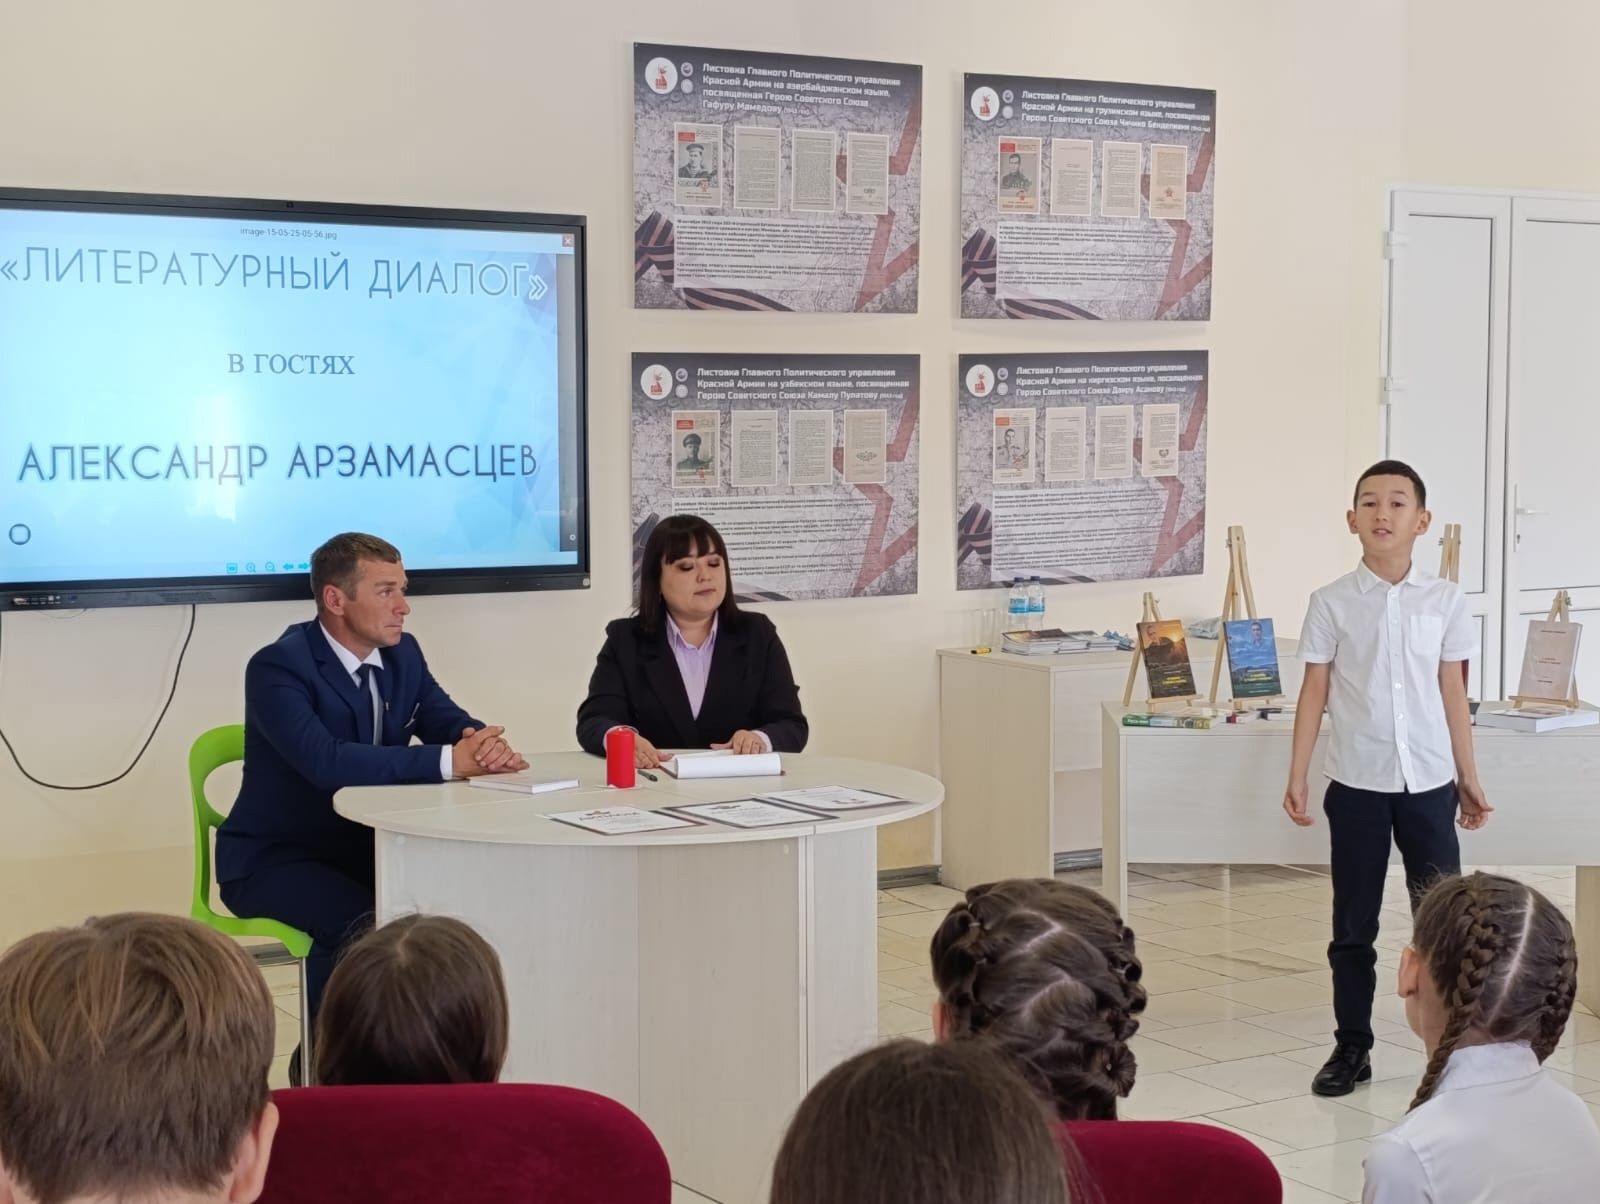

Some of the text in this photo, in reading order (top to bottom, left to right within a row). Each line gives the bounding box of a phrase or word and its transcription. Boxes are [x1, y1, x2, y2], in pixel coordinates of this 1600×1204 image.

[702, 62, 901, 86] Листовка Главного Политического управления
[702, 75, 741, 87] Красной
[743, 78, 772, 89] Армии
[773, 82, 784, 90] на
[786, 81, 862, 96] азербайджанском
[702, 99, 735, 111] Гафуру
[765, 91, 793, 103] Герою
[794, 93, 842, 105] Советского
[843, 97, 869, 107] Союза
[1021, 90, 1060, 101] Листовка
[1061, 93, 1097, 103] Главного
[1098, 95, 1154, 107] Политического
[1021, 101, 1056, 112] Красной
[1057, 103, 1082, 114] Армии
[1084, 105, 1094, 114] на
[1021, 112, 1048, 123] Герою
[1048, 114, 1094, 126] Советского
[1094, 116, 1118, 127] Союза
[0, 246, 549, 301] «ЛИТЕРАТУРНЫЙ ДИАЛОГ»
[697, 367, 896, 378] Листовка Главного Политического управления
[697, 379, 735, 389] Красной
[737, 379, 766, 389] Армии
[780, 379, 825, 390] узбекском
[1077, 377, 1087, 385] на
[697, 391, 726, 401] Герою
[727, 391, 777, 400] Советского
[778, 390, 806, 400] Союза
[16, 443, 537, 486] АЛЕКСАНДР АРЗАМАСЦЕВ
